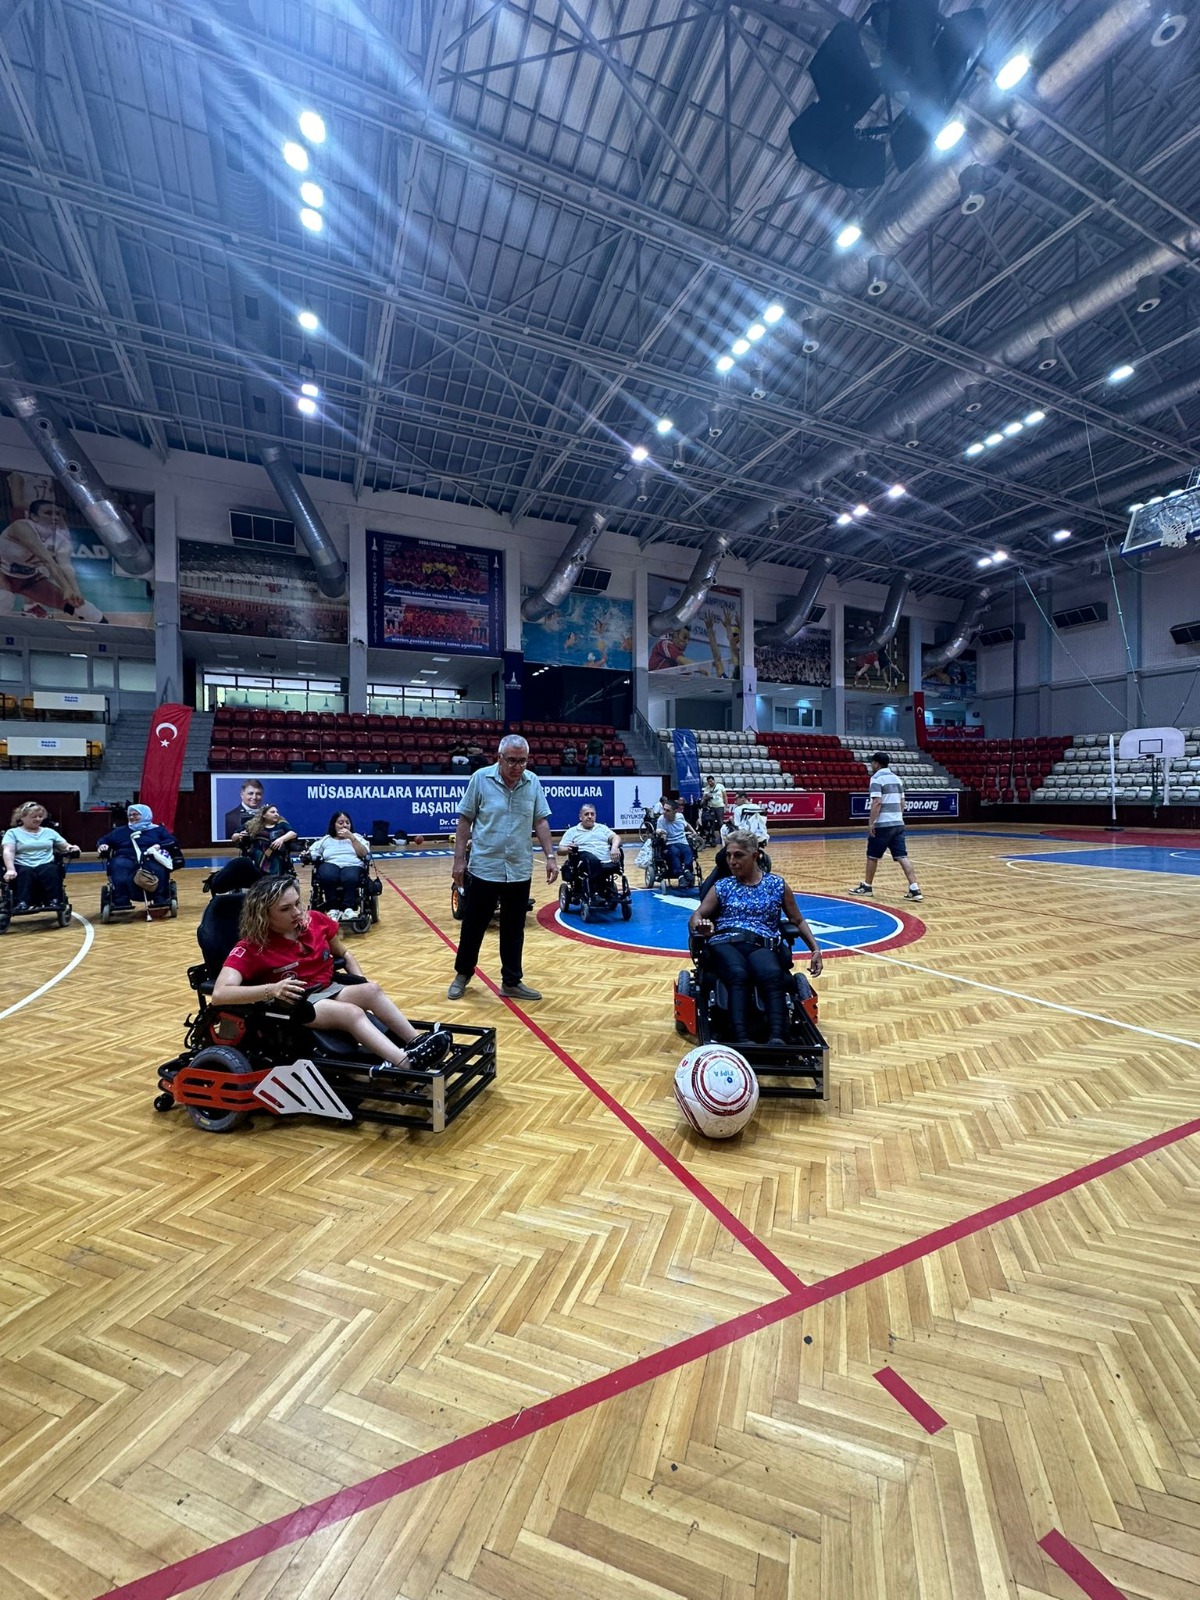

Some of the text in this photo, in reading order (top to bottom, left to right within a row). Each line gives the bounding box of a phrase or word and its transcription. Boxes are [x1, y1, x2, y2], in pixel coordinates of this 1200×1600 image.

[307, 783, 413, 799] MÜSABAKALARA
[415, 786, 466, 798] KATILAN
[439, 818, 450, 826] Dr.
